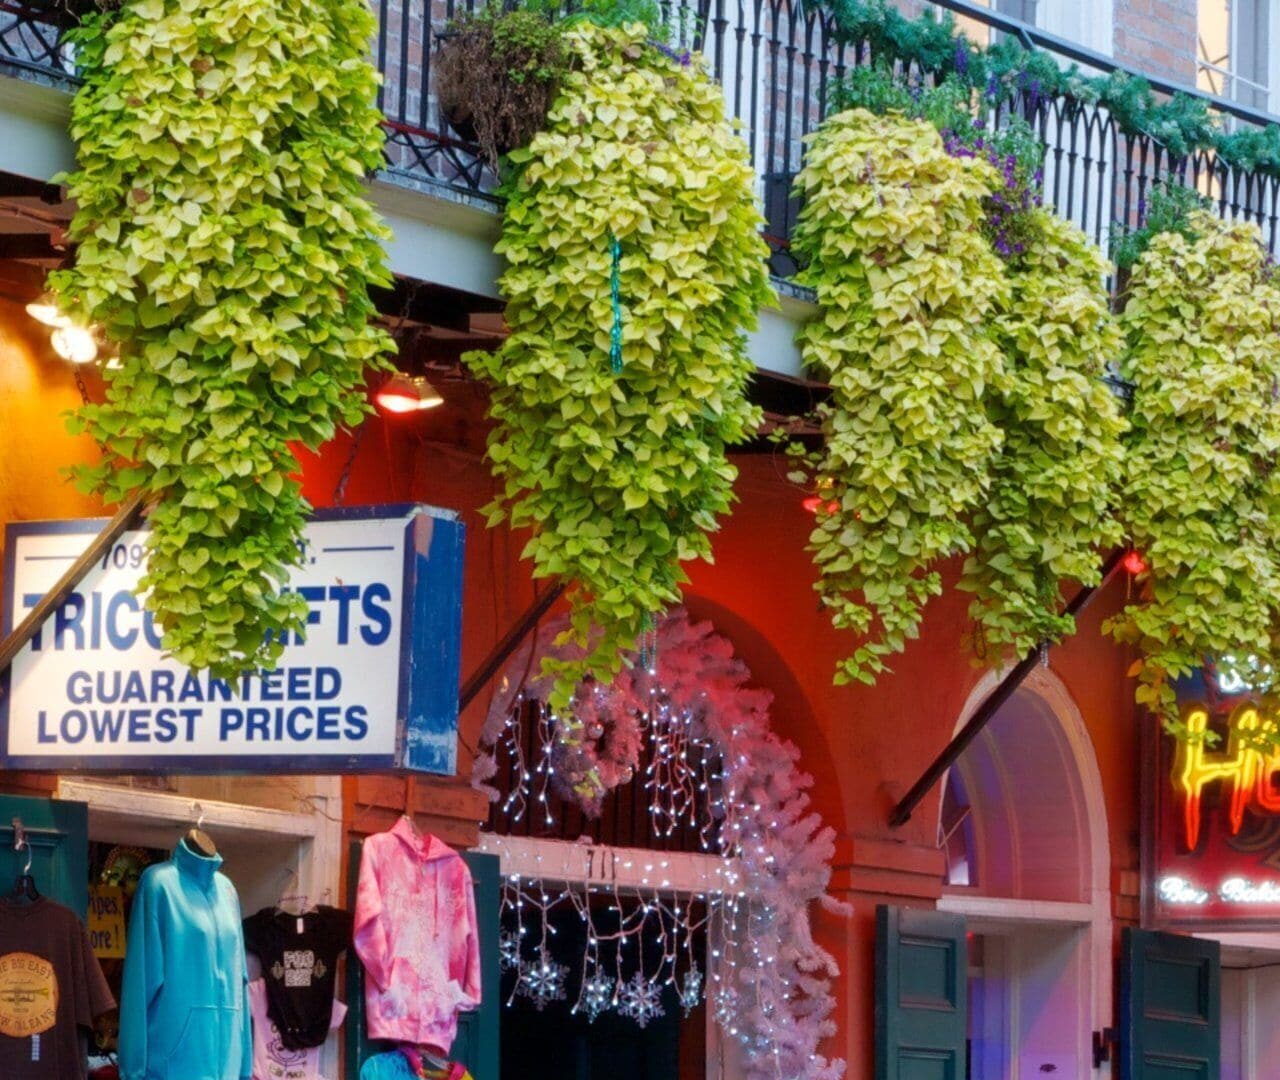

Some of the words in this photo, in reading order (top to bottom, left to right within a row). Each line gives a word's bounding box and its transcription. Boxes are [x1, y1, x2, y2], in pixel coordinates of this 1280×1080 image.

[66, 666, 342, 704] GUARANTEED
[37, 708, 203, 744] LOWEST
[219, 705, 369, 743] PRICES
